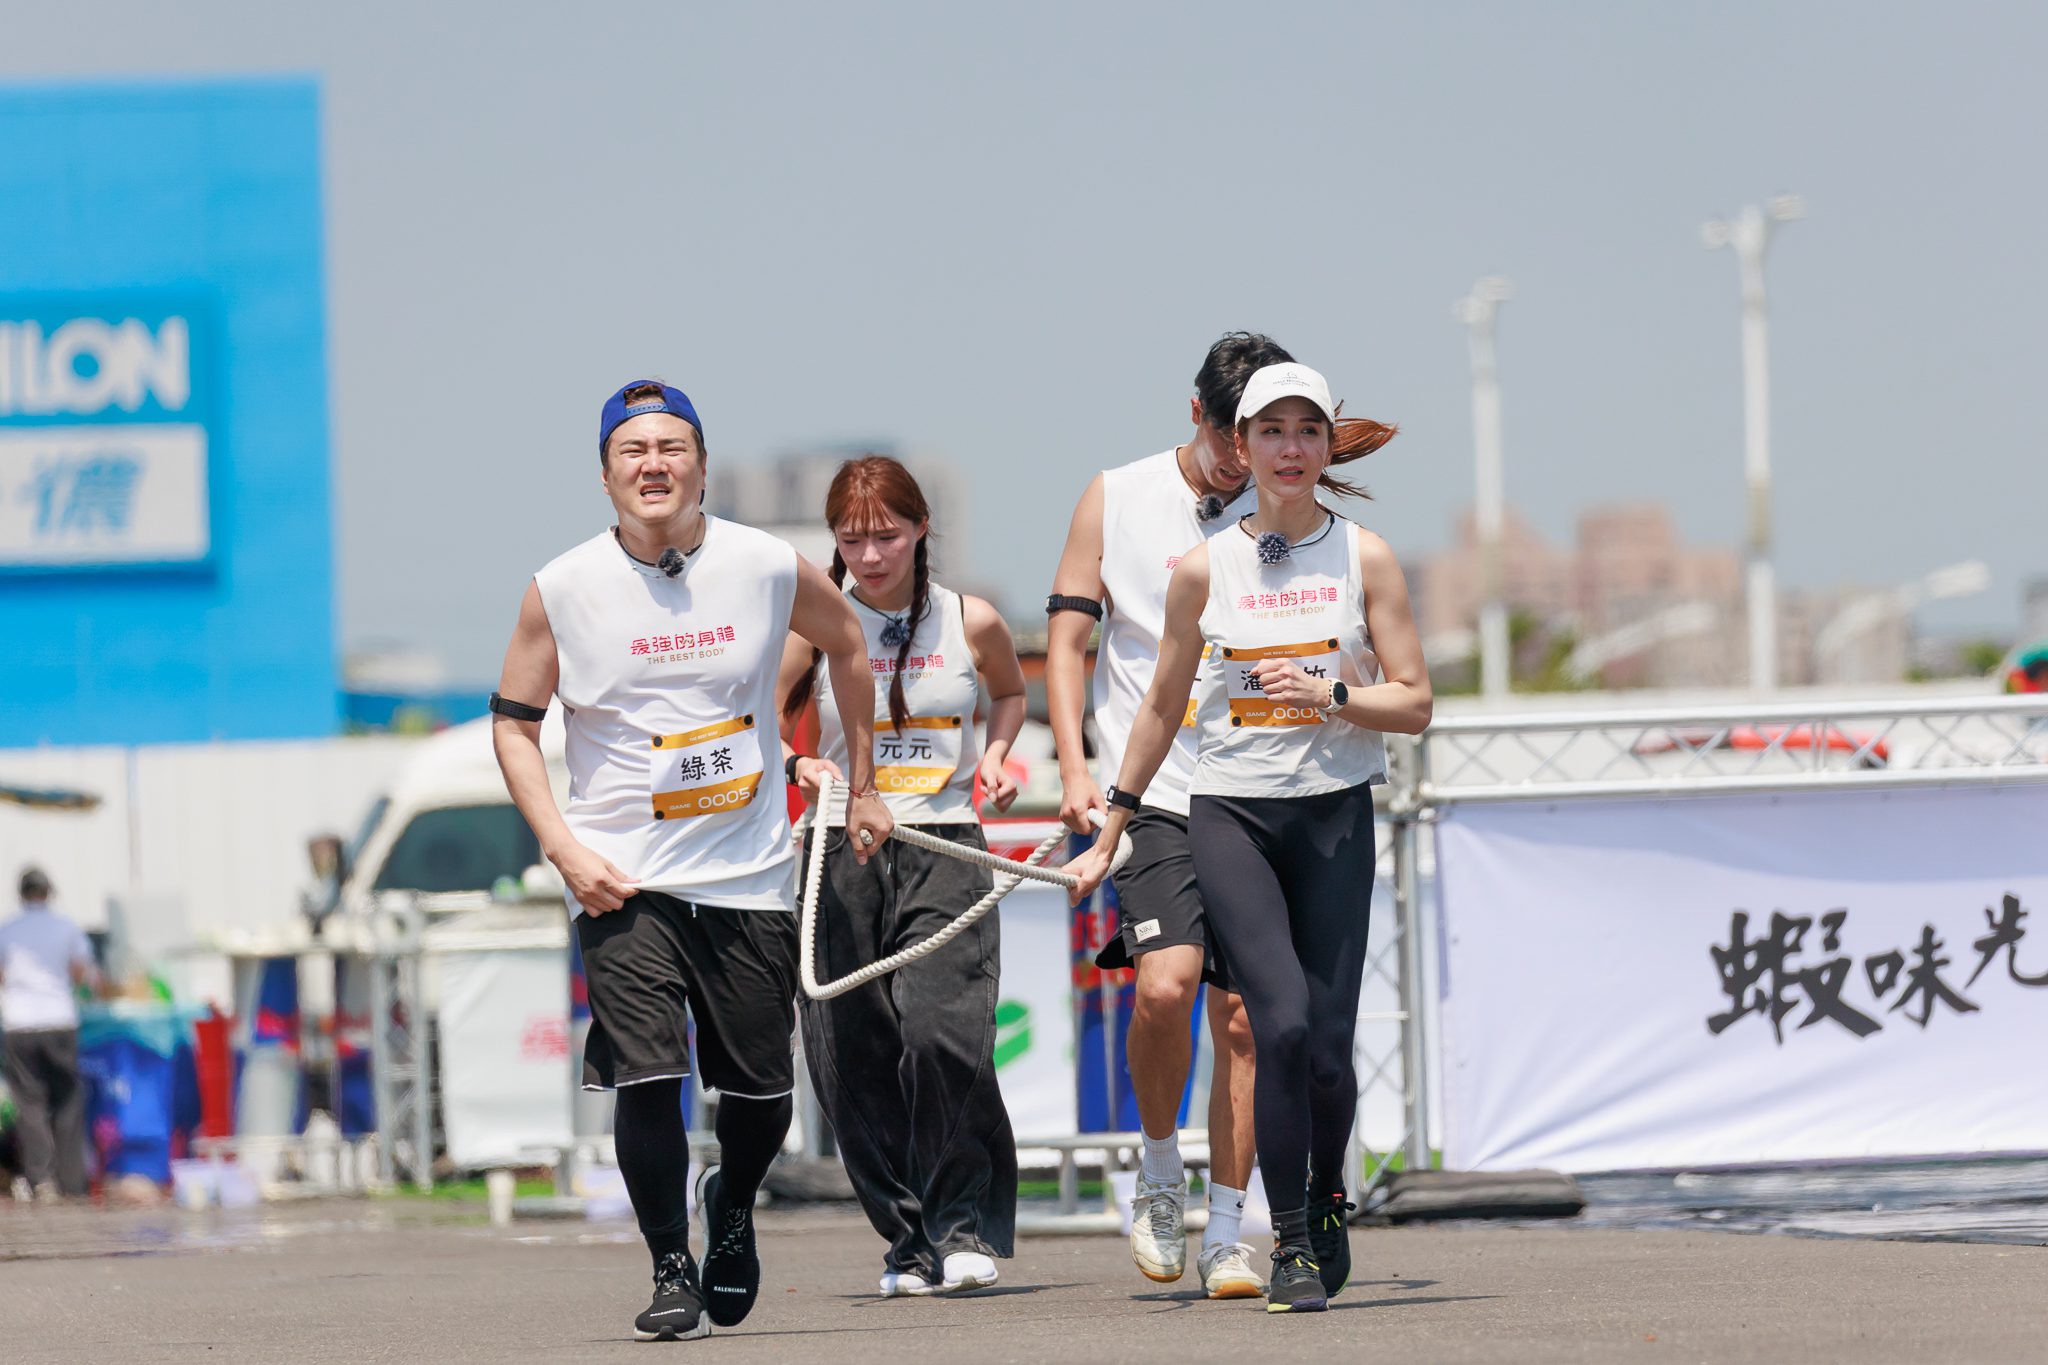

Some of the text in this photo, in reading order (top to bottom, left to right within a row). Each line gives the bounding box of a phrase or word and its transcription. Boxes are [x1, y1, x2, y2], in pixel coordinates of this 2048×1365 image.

[1237, 587, 1338, 610] 最強的身體
[1251, 605, 1326, 619] THE BEST BODY
[629, 625, 736, 657] 最強的身體
[646, 646, 725, 665] THE BEST BODY
[908, 671, 934, 681] BODY
[880, 737, 932, 760] 元元
[680, 746, 733, 782] 綠茶
[890, 775, 943, 788] 0005
[669, 785, 751, 811] GAME 0005
[714, 1286, 746, 1294] BALENCIAGA
